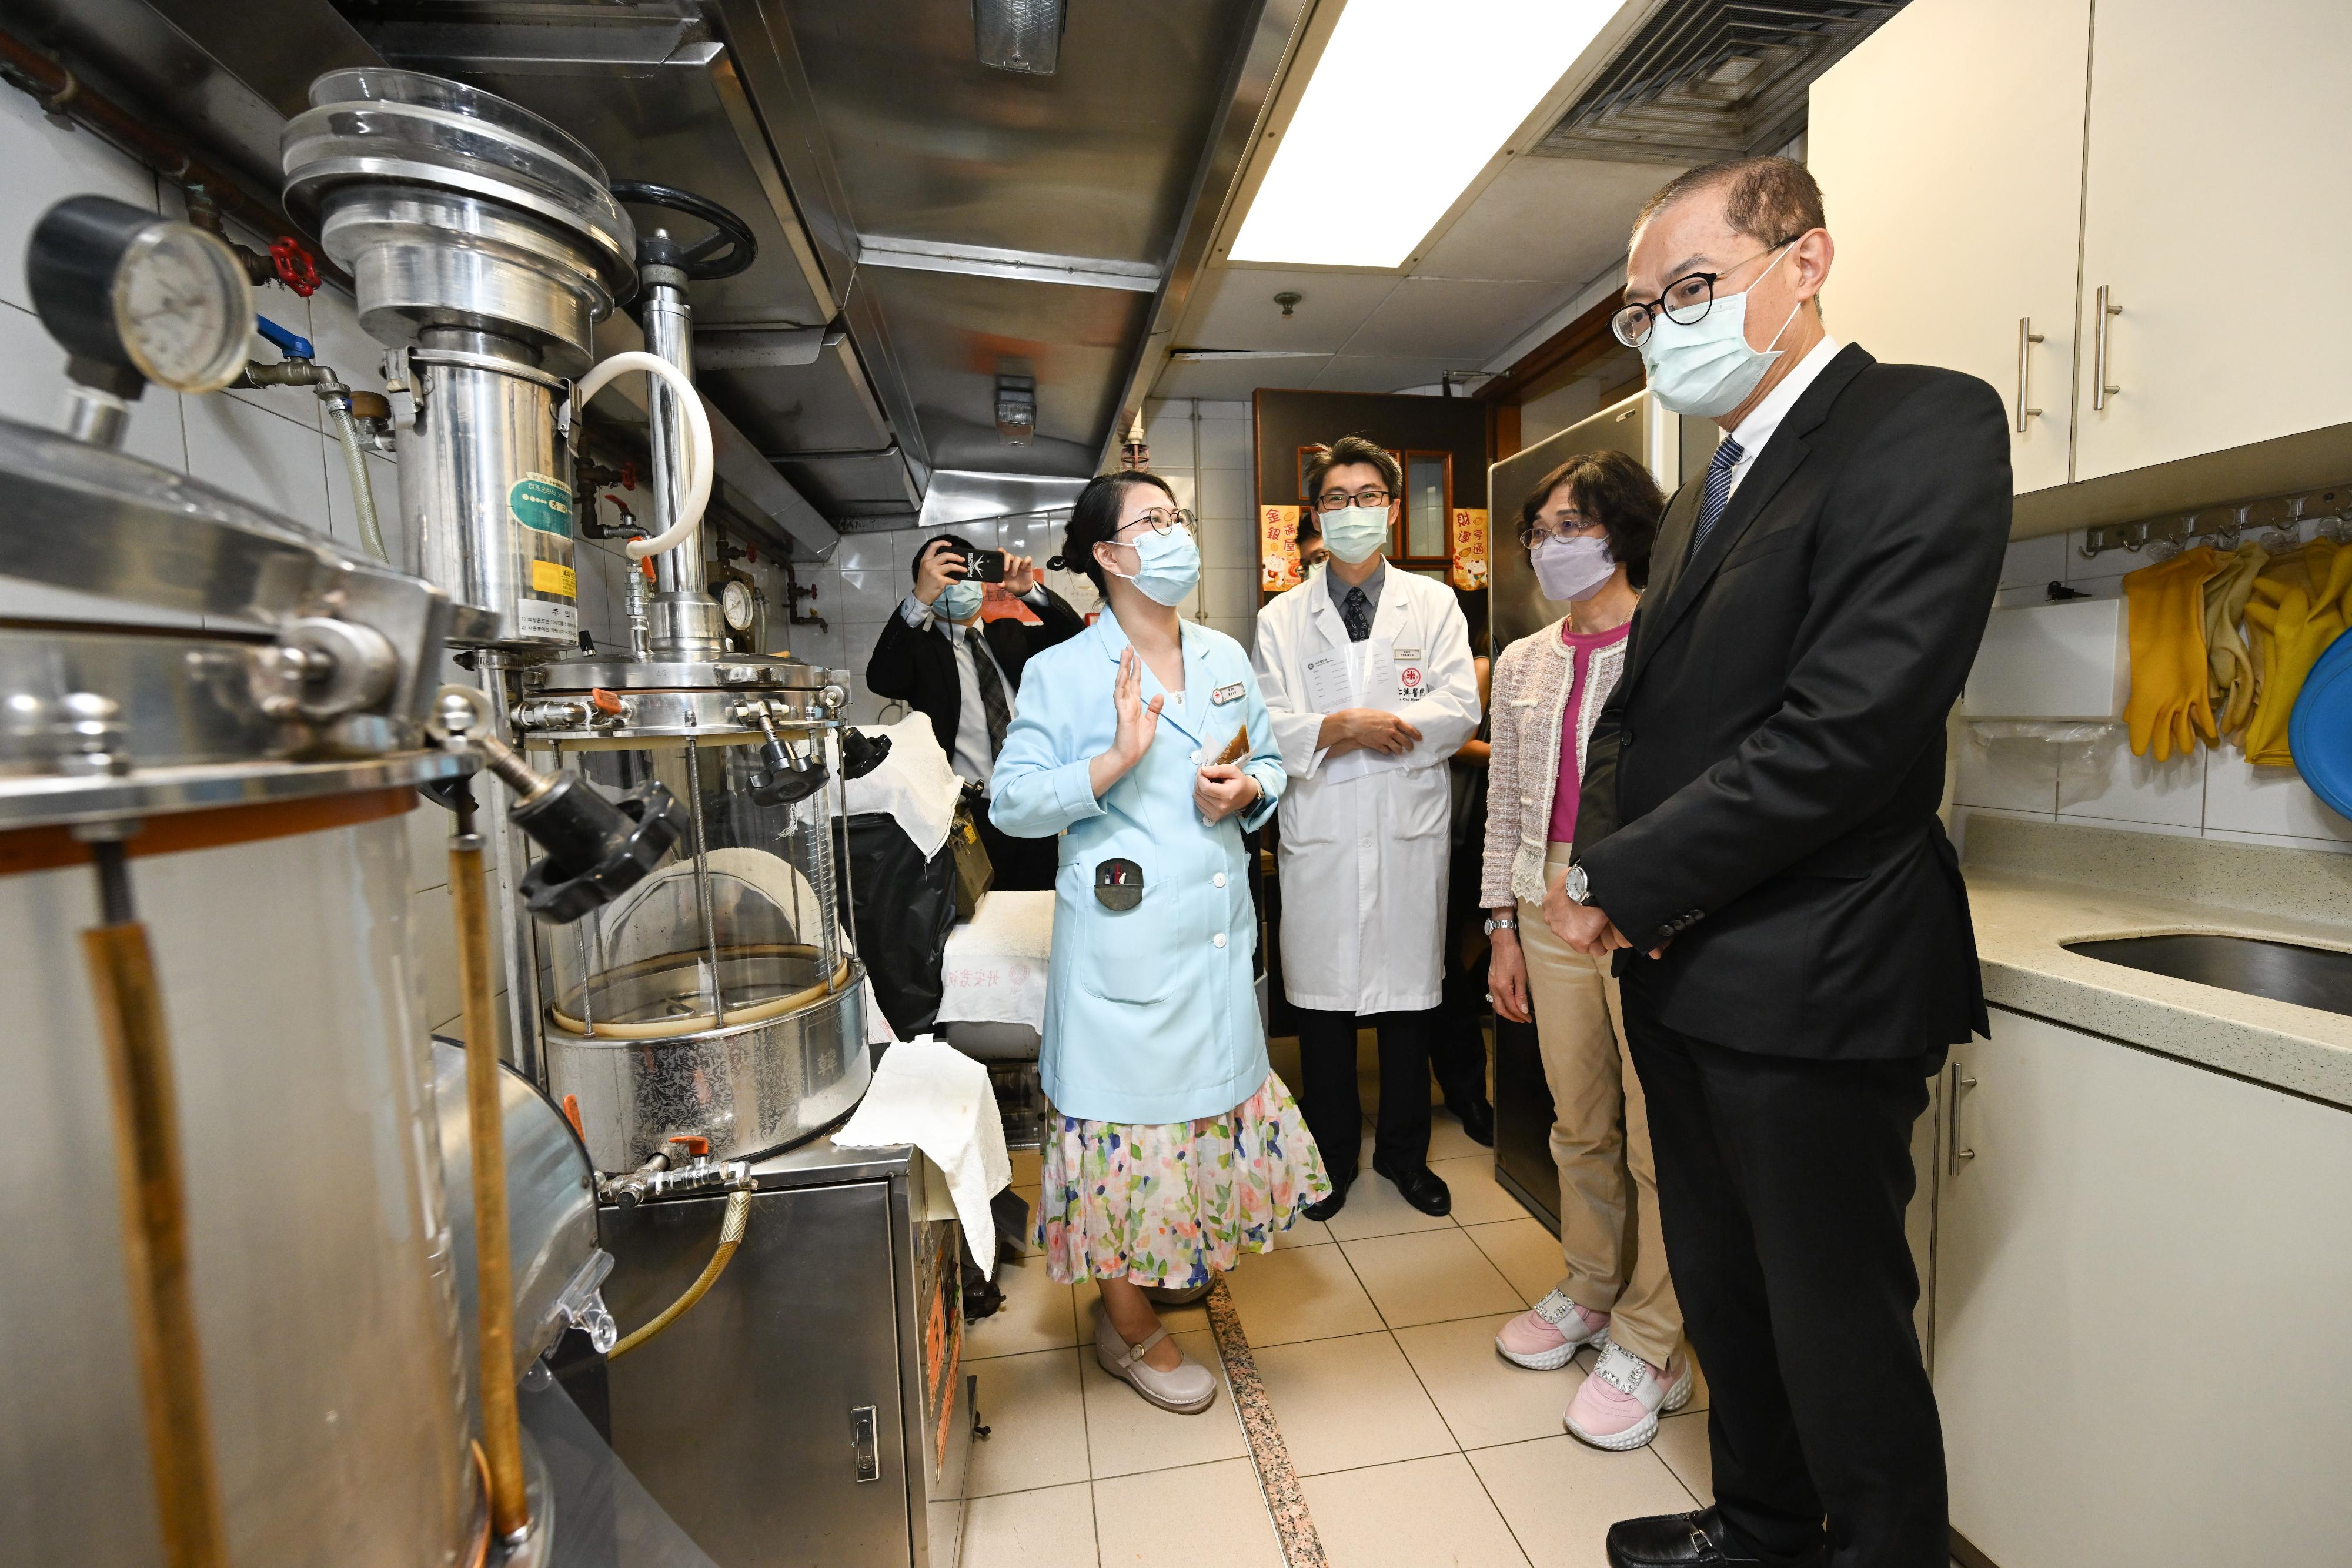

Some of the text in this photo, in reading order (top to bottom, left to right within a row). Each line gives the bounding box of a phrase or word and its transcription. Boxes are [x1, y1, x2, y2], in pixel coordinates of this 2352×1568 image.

[1266, 508, 1281, 541] 金銀
[1456, 512, 1471, 543] 財運
[1473, 530, 1484, 555] 亨通
